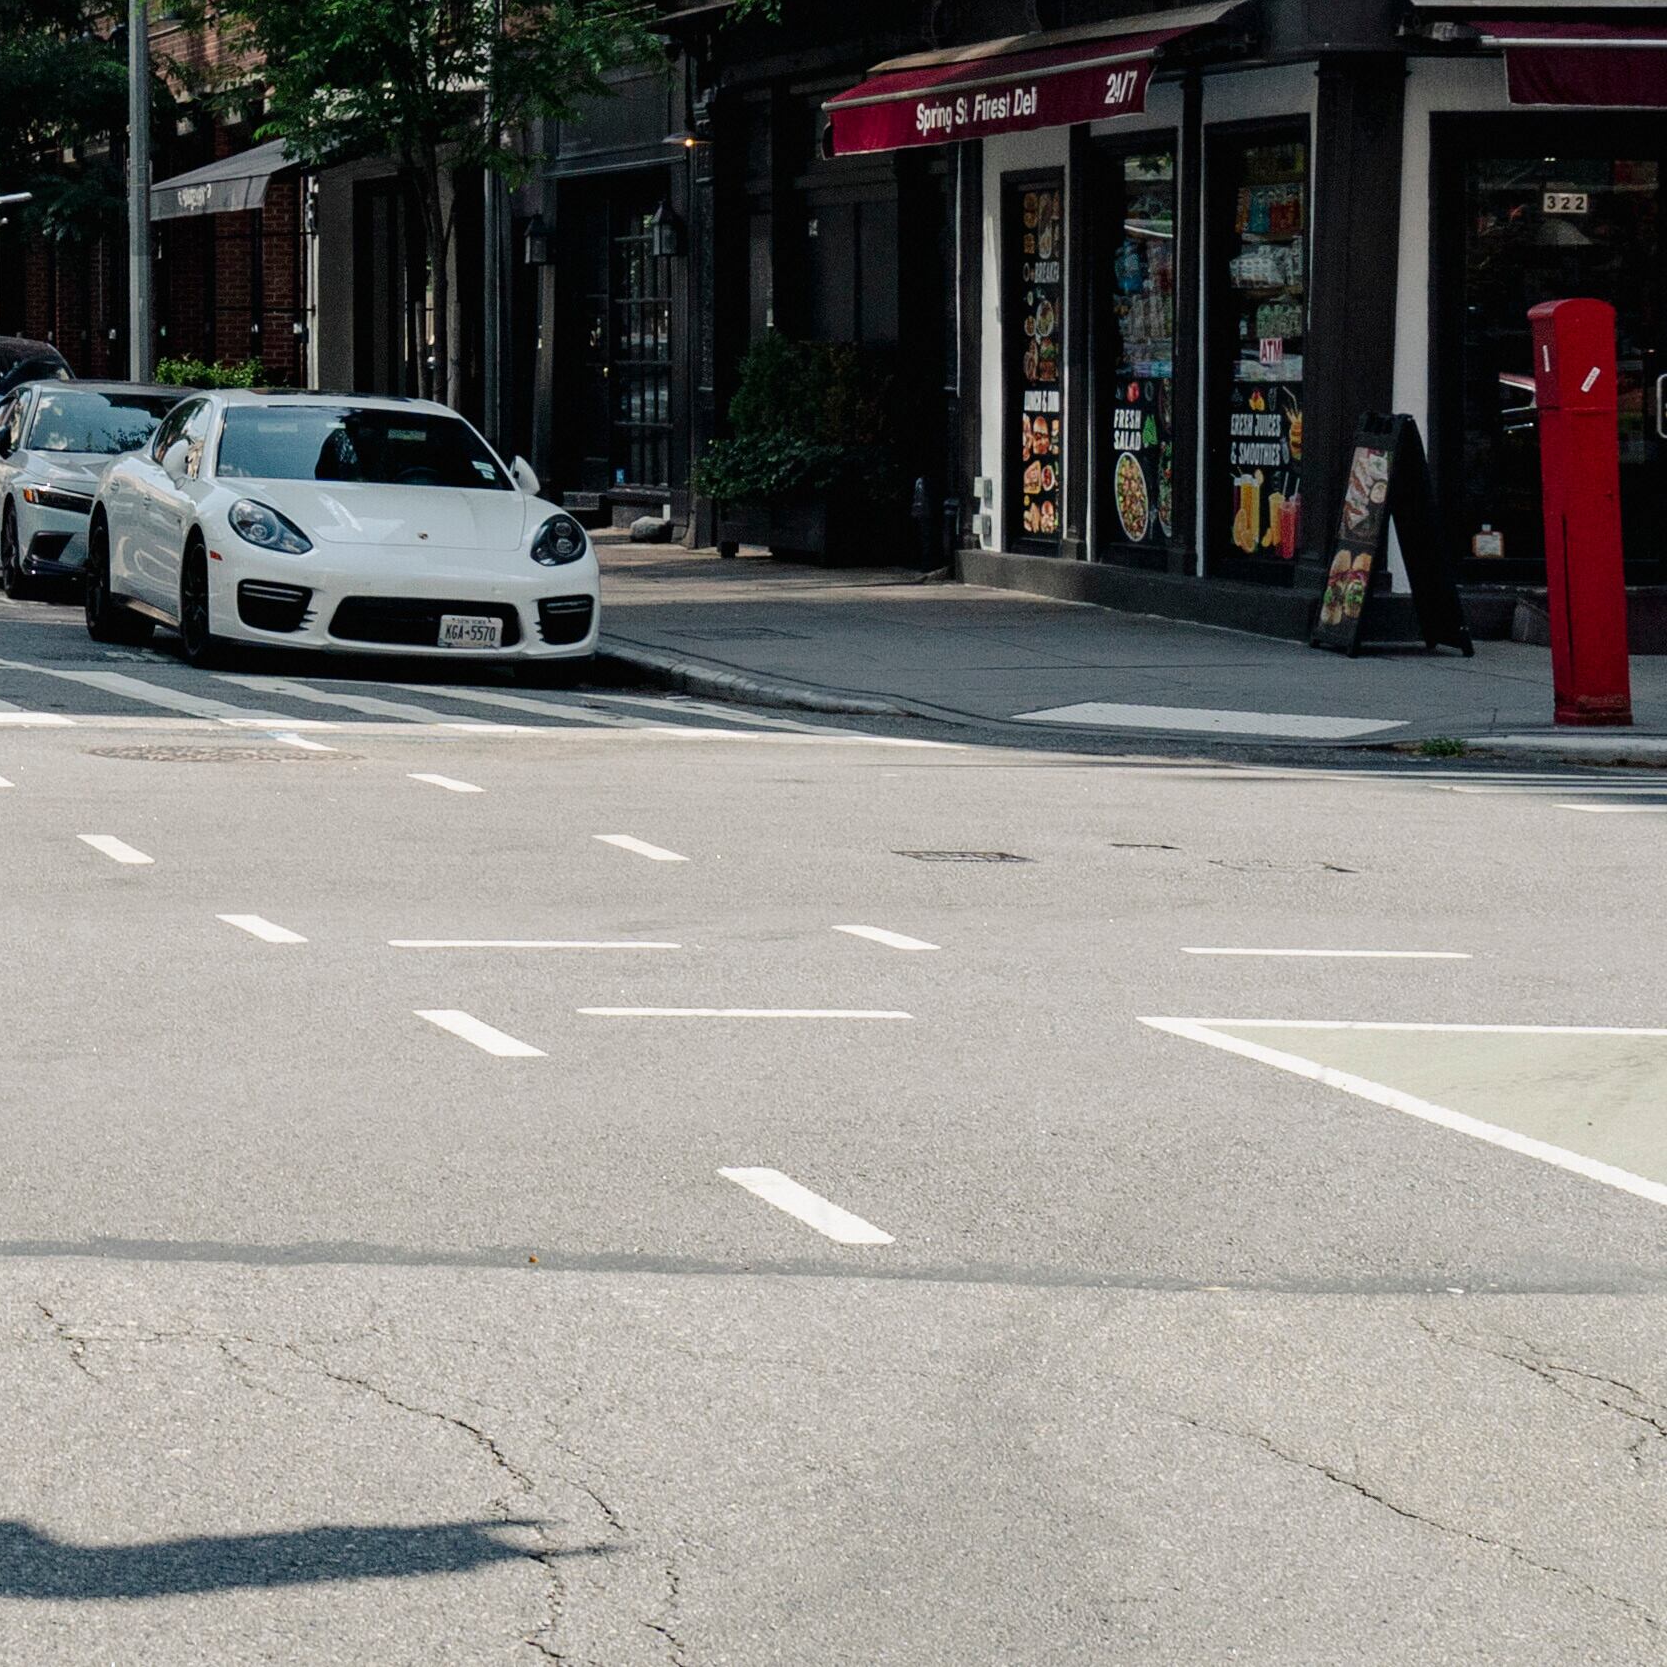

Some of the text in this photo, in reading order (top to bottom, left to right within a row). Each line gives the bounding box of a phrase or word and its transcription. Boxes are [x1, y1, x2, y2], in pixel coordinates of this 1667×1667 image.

[915, 101, 953, 137] Spring
[1013, 86, 1038, 116] Deli
[1104, 70, 1138, 104] 24/7
[1547, 195, 1585, 211] 322
[1260, 338, 1283, 363] ATM
[1114, 409, 1142, 430] FRESH
[1230, 414, 1282, 437] FRESH JUICES
[1113, 430, 1142, 451] SALAD
[1230, 441, 1281, 466] & SMOOTHIES
